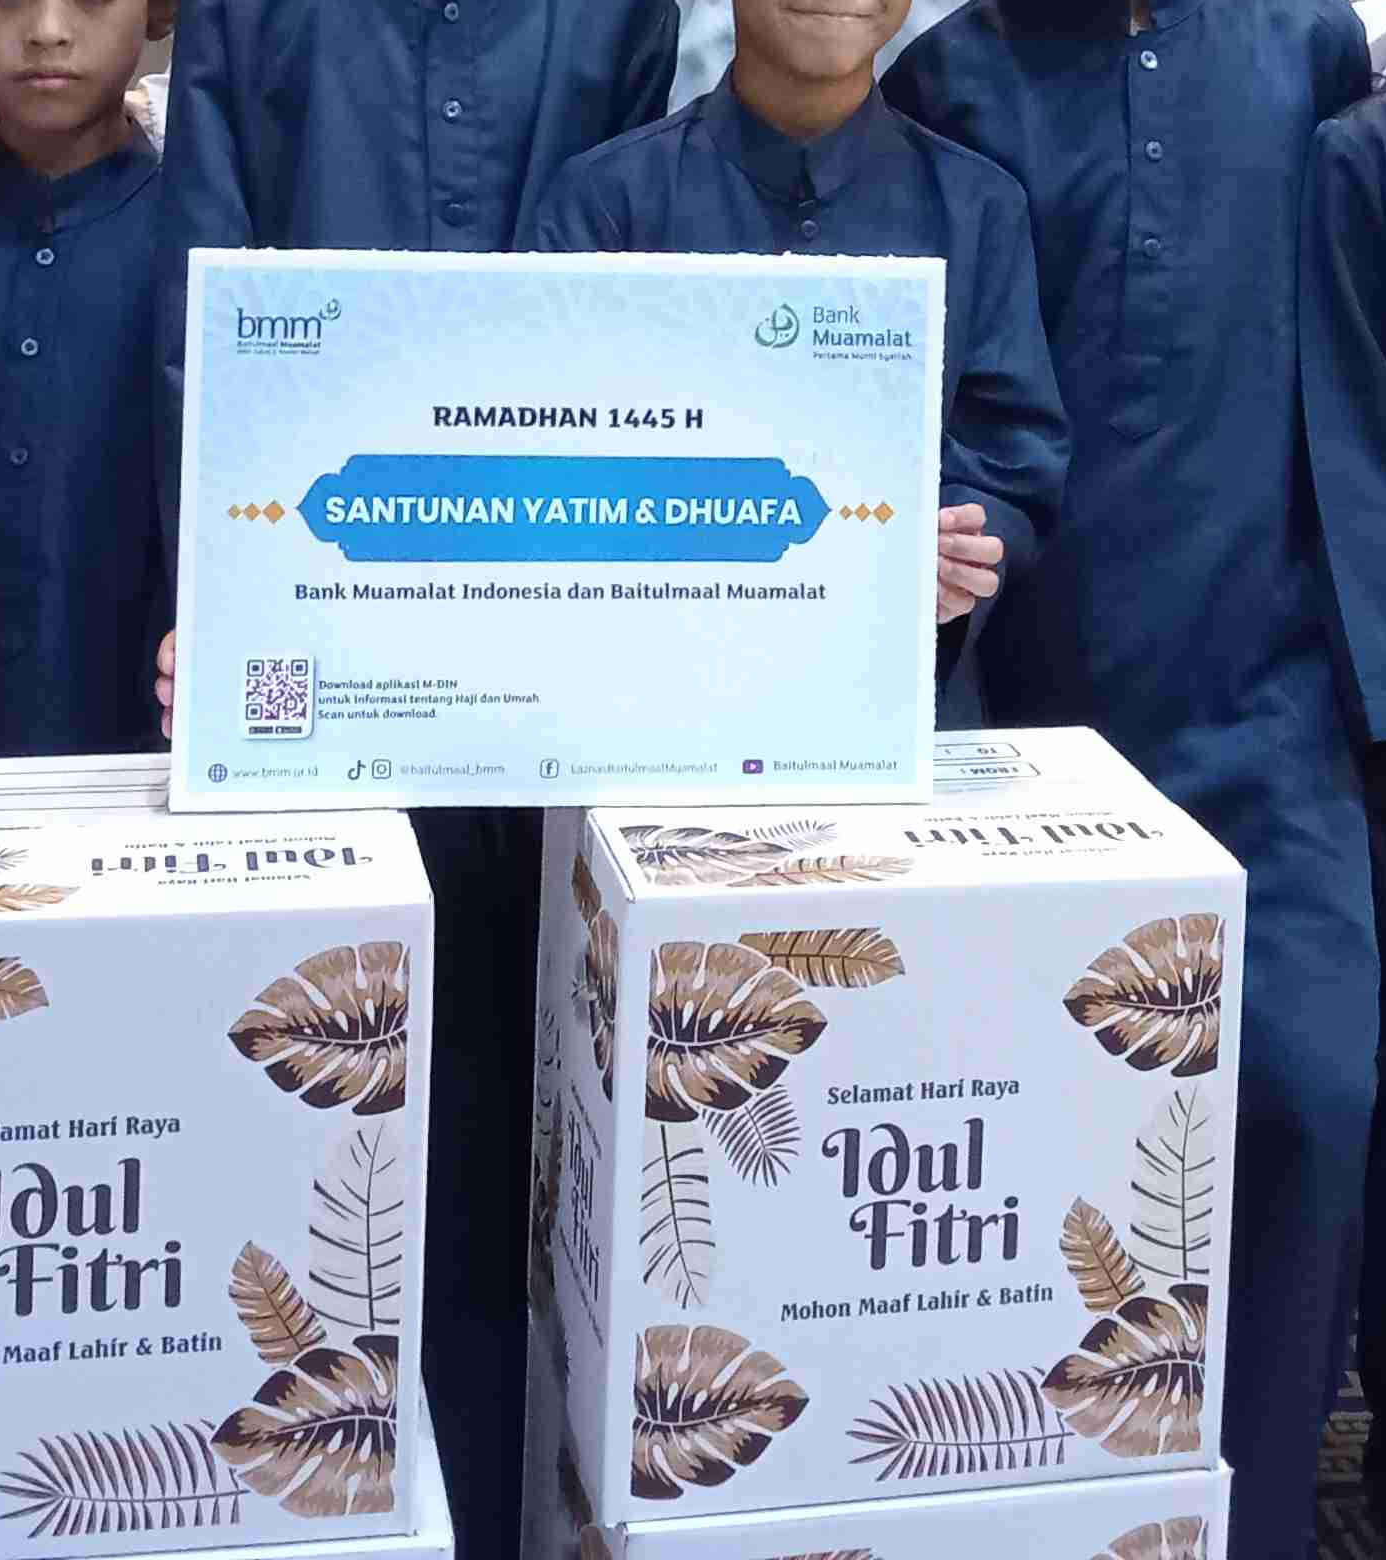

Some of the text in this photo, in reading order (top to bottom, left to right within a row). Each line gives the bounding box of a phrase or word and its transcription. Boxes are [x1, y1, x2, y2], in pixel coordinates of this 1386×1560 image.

[237, 307, 322, 339] bmm
[813, 305, 861, 324] Bank
[813, 329, 912, 347] Muamalat
[433, 405, 705, 430] RAMADHAN 1445 H
[325, 496, 804, 526] SANTUNAN YATIM & DHUAFA
[295, 583, 827, 601] Bank Muamalat Indonesia dan Baitulmaal Muamalat
[319, 679, 458, 691] Download aplikasi M-DIN
[318, 695, 351, 705] untuk
[409, 694, 453, 706] tentang
[455, 694, 478, 706] Haji
[480, 693, 500, 703] dan
[318, 710, 345, 720] Scan
[347, 709, 380, 719] untuk
[773, 759, 898, 771] Baitulmaal Muamalat
[245, 847, 374, 872] Idul
[827, 1079, 1020, 1105] Selamat Hari Raya
[68, 1116, 117, 1138] Hari
[126, 1115, 181, 1139] Raya
[822, 1117, 984, 1198] Idul
[849, 1195, 1019, 1270] Fitri
[781, 1284, 1053, 1322] Mohon Maaf Lahir & Batin
[2, 1341, 61, 1364] Maaf
[69, 1337, 128, 1360] Lahir
[136, 1337, 153, 1356] &
[162, 1331, 222, 1355] Batin
